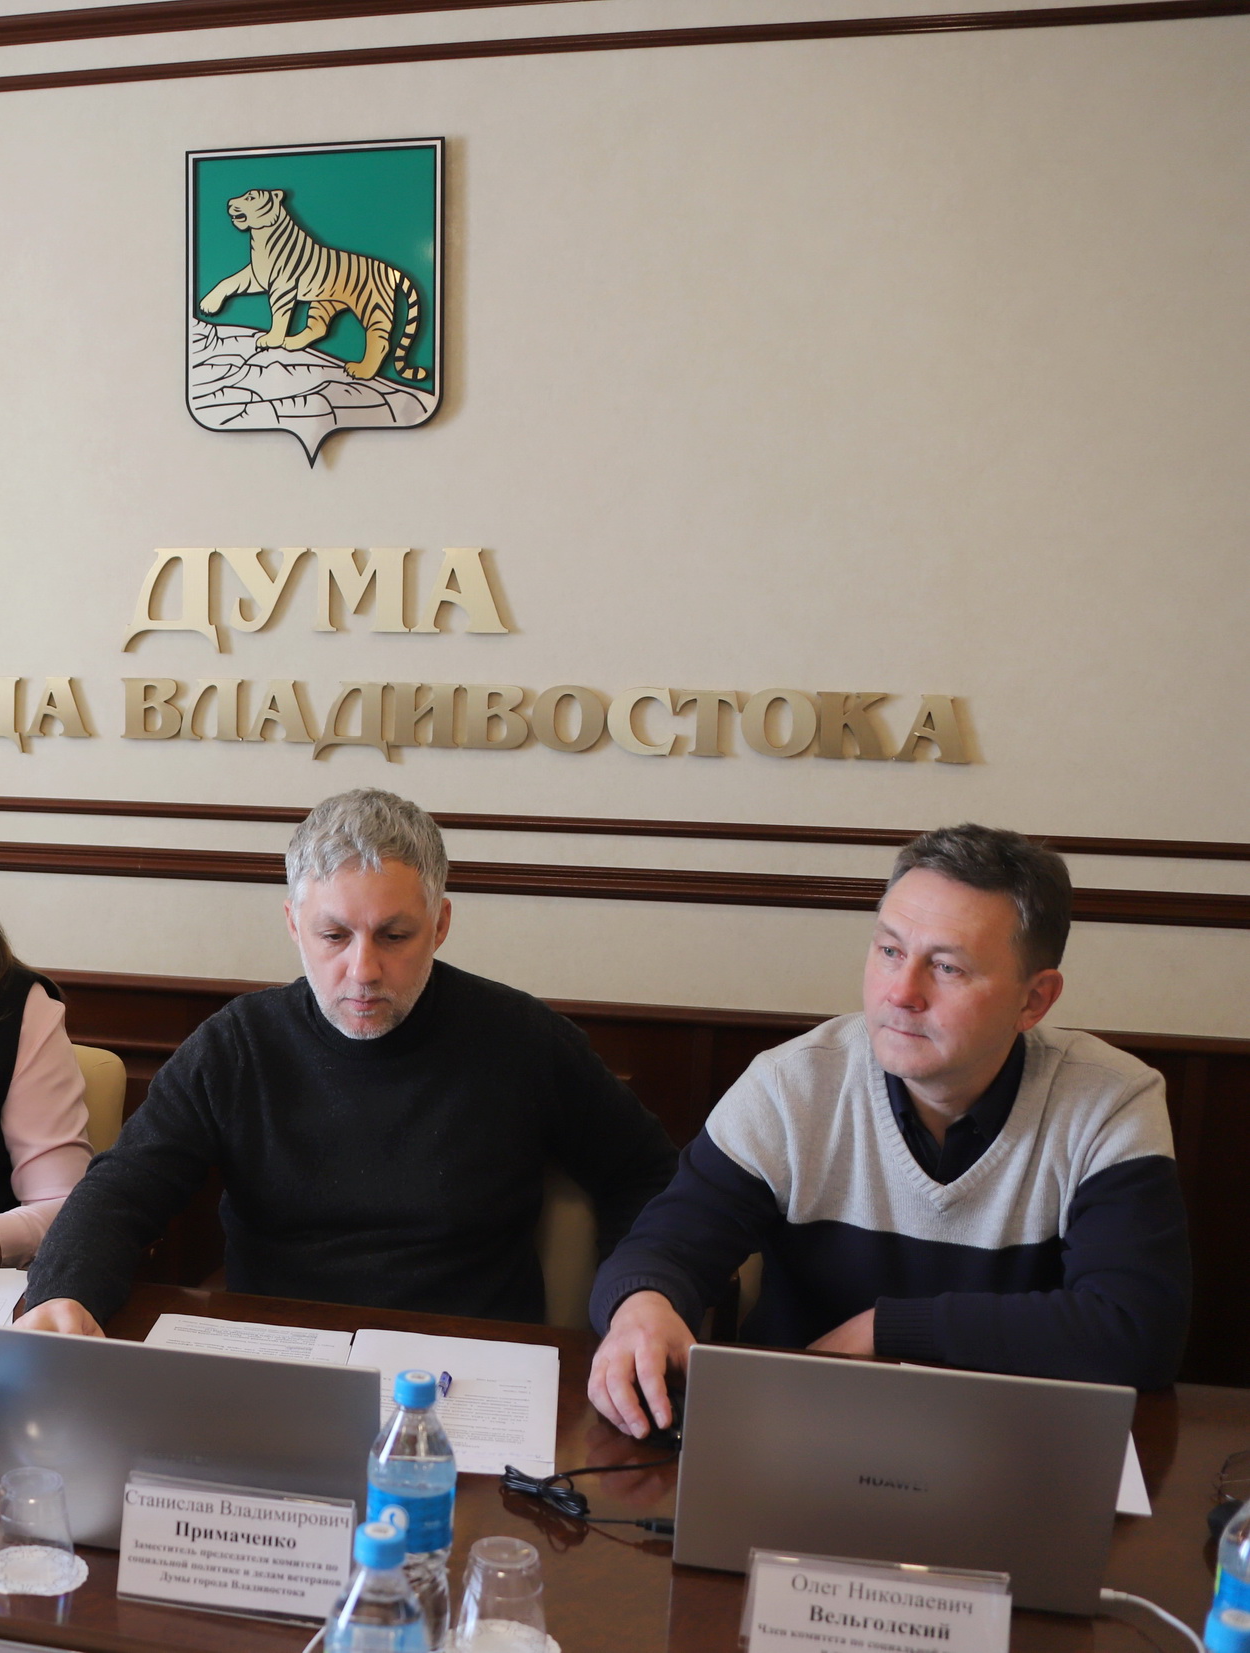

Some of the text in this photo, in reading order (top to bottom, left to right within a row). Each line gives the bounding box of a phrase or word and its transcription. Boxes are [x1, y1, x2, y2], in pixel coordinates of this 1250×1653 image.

[121, 547, 509, 653] ДУМА
[121, 677, 971, 765] ВЛАДИВОСТОКА
[125, 1489, 350, 1528] Станислав Владимирович
[175, 1521, 297, 1549] Примаченко
[128, 1554, 189, 1569] социальной
[191, 1562, 240, 1576] политике
[252, 1569, 285, 1581] делам
[287, 1573, 342, 1587] ветеранов
[133, 1540, 338, 1572] Заместитель председателя комитета по
[160, 1571, 306, 1598] Думы города Владивостока
[791, 1573, 974, 1615] Олег Николаевич
[809, 1604, 951, 1640] Вельгодский
